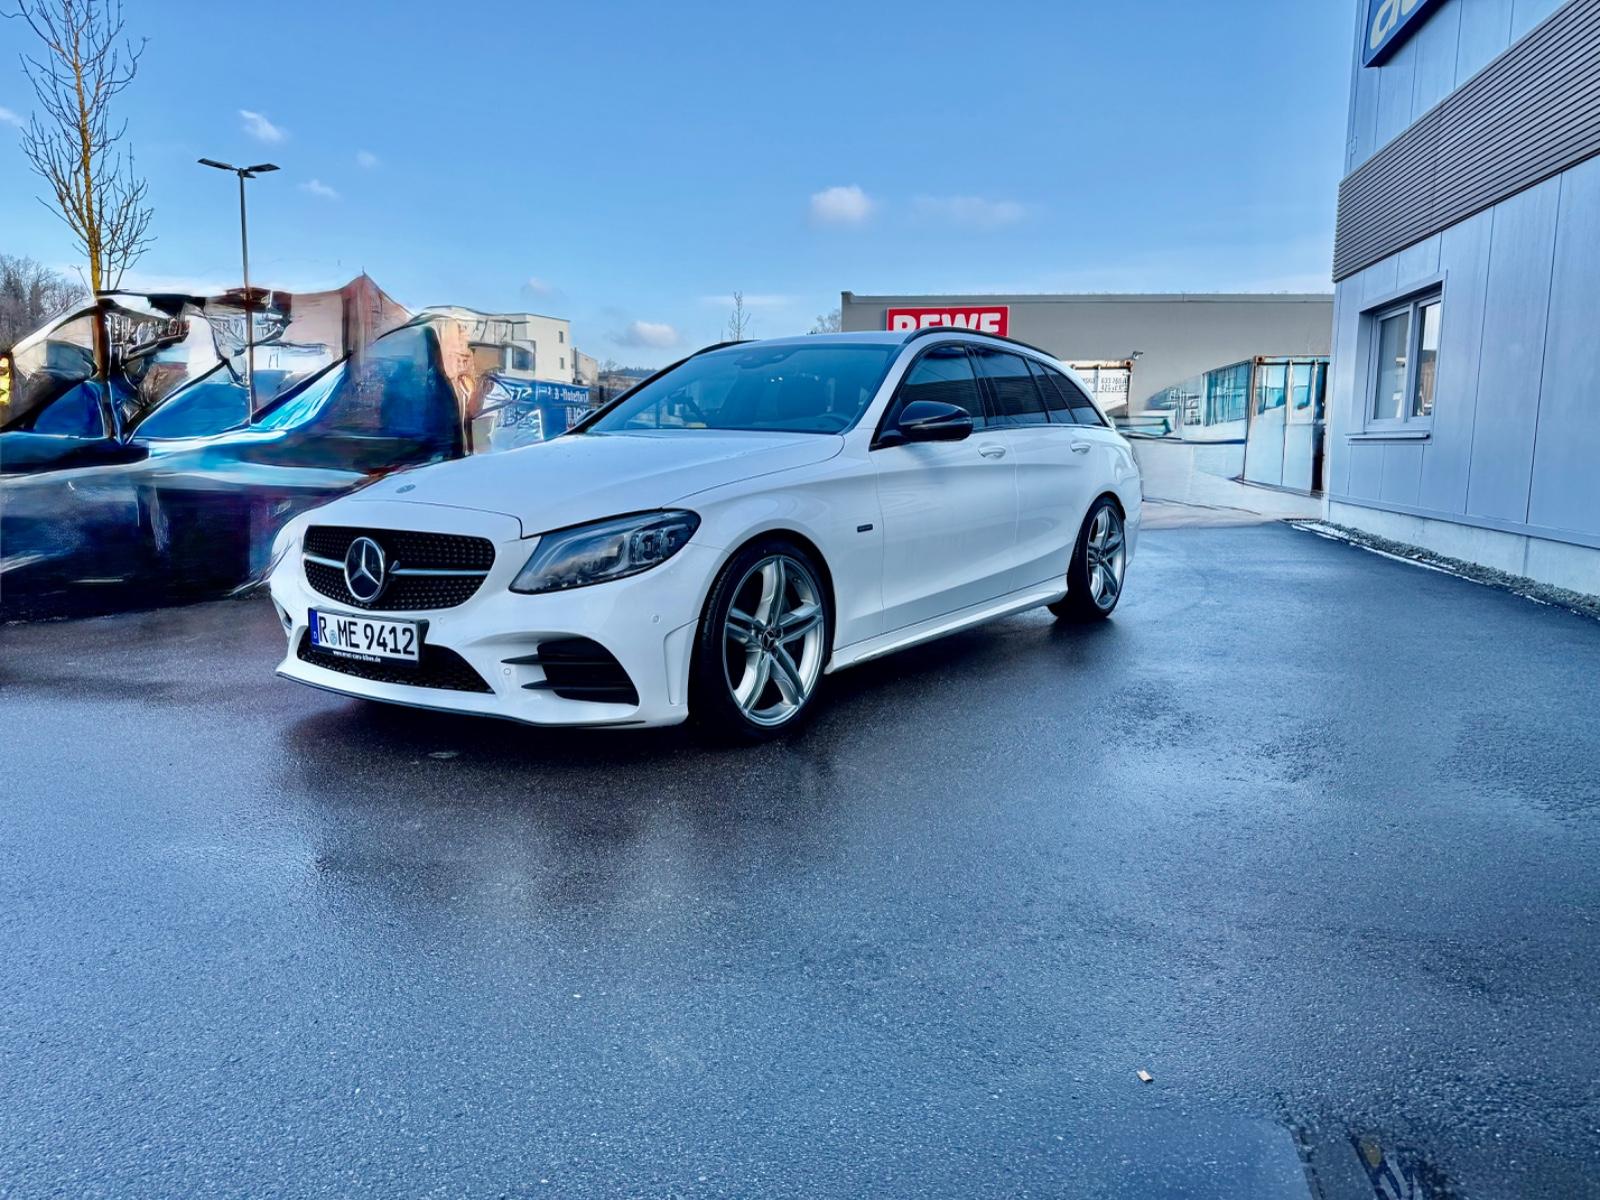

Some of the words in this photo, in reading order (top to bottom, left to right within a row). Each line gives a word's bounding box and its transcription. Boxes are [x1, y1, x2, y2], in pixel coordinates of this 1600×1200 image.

[319, 616, 328, 643] R
[337, 619, 360, 649] ME
[363, 623, 415, 655] 9412
